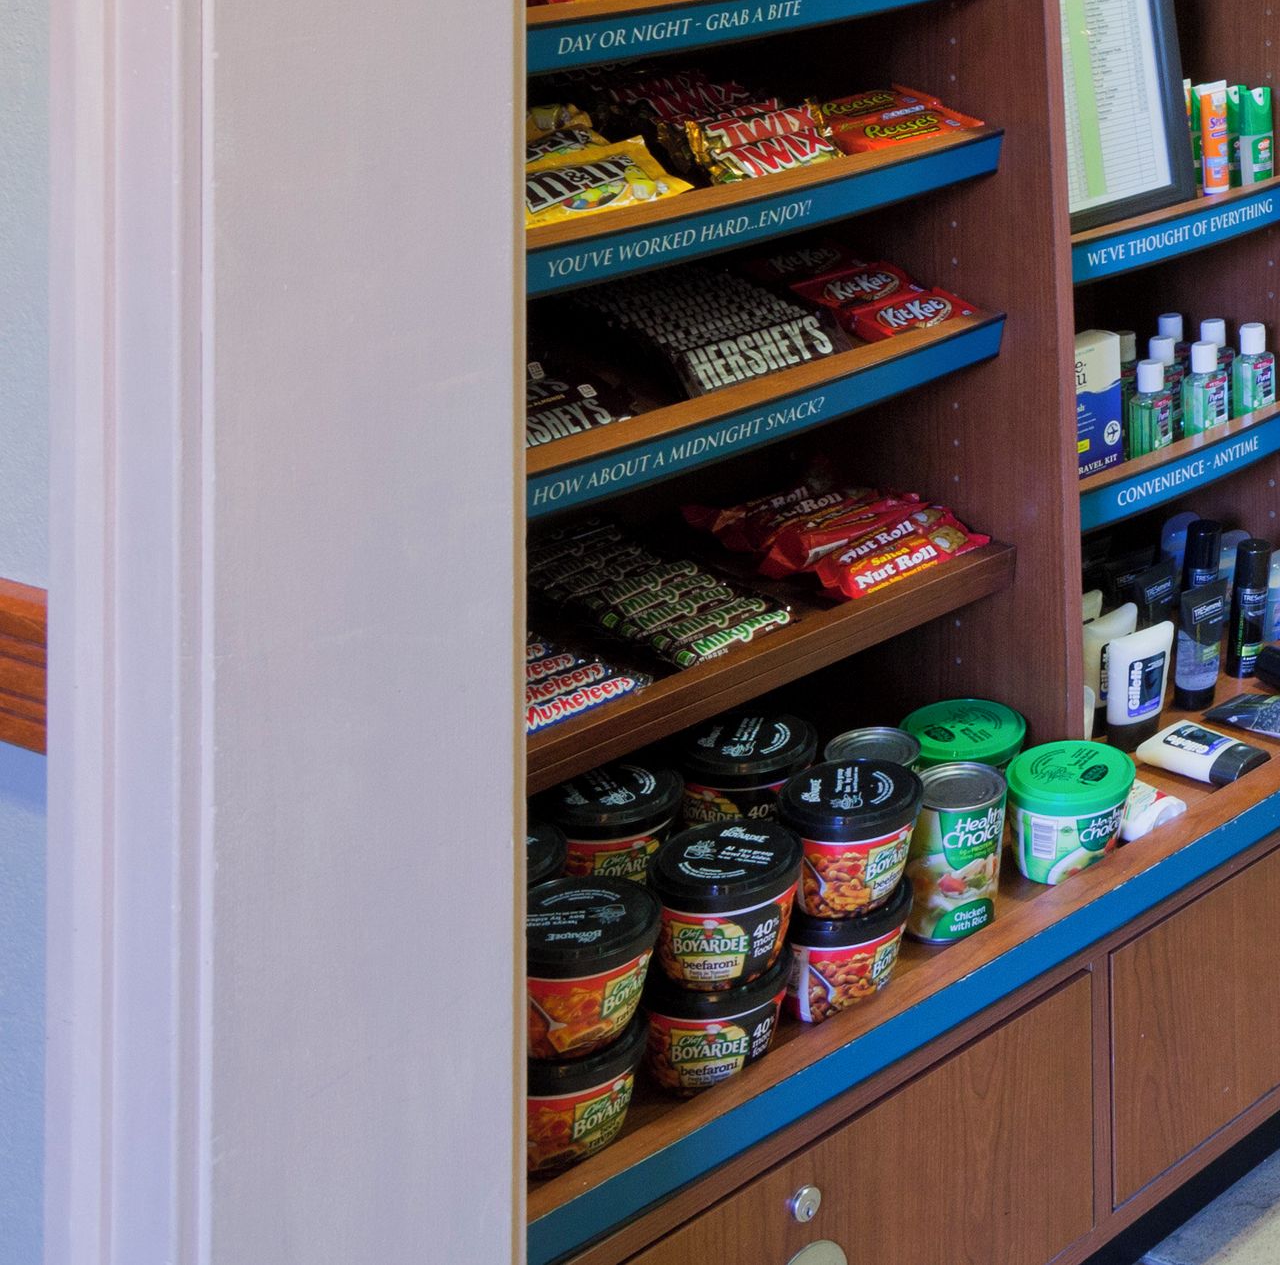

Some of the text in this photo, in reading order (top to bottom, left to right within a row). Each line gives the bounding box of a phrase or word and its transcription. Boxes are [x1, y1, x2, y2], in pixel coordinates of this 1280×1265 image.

[557, 32, 597, 56] DAY
[599, 30, 627, 50] OR
[630, 18, 694, 46] NIGHT
[705, 8, 751, 32] GRAB
[751, 8, 764, 22] A
[767, 0, 804, 21] BITE
[706, 105, 818, 147] TWIX
[711, 127, 835, 178] TWIX
[1088, 198, 1273, 267] WE'VE THOUGHT OF EVERYTHING
[548, 244, 614, 277] YOU'VE
[618, 228, 697, 261] WORKED
[686, 315, 834, 391] HERSHEY'S
[532, 396, 826, 506] HOW ABOUT A MIDNIGHT SNACK?
[1078, 453, 1118, 475] RAVEL KIT
[1116, 459, 1205, 507] CONVENIENCE
[1212, 435, 1260, 469] ANYTIME
[880, 519, 916, 543] Roll
[855, 565, 897, 590] Nut
[894, 544, 939, 572] Roll
[871, 546, 910, 567] Salted
[942, 823, 1002, 850] Choice
[949, 913, 988, 933] with Rice
[953, 904, 986, 922] Chicken
[672, 934, 750, 955] BOYARDEE
[680, 928, 703, 940] Chef
[682, 956, 739, 972] beefaroni
[671, 1036, 750, 1063] BOYARDEE
[680, 1035, 704, 1047] Chef
[681, 1058, 739, 1076] beefaroni
